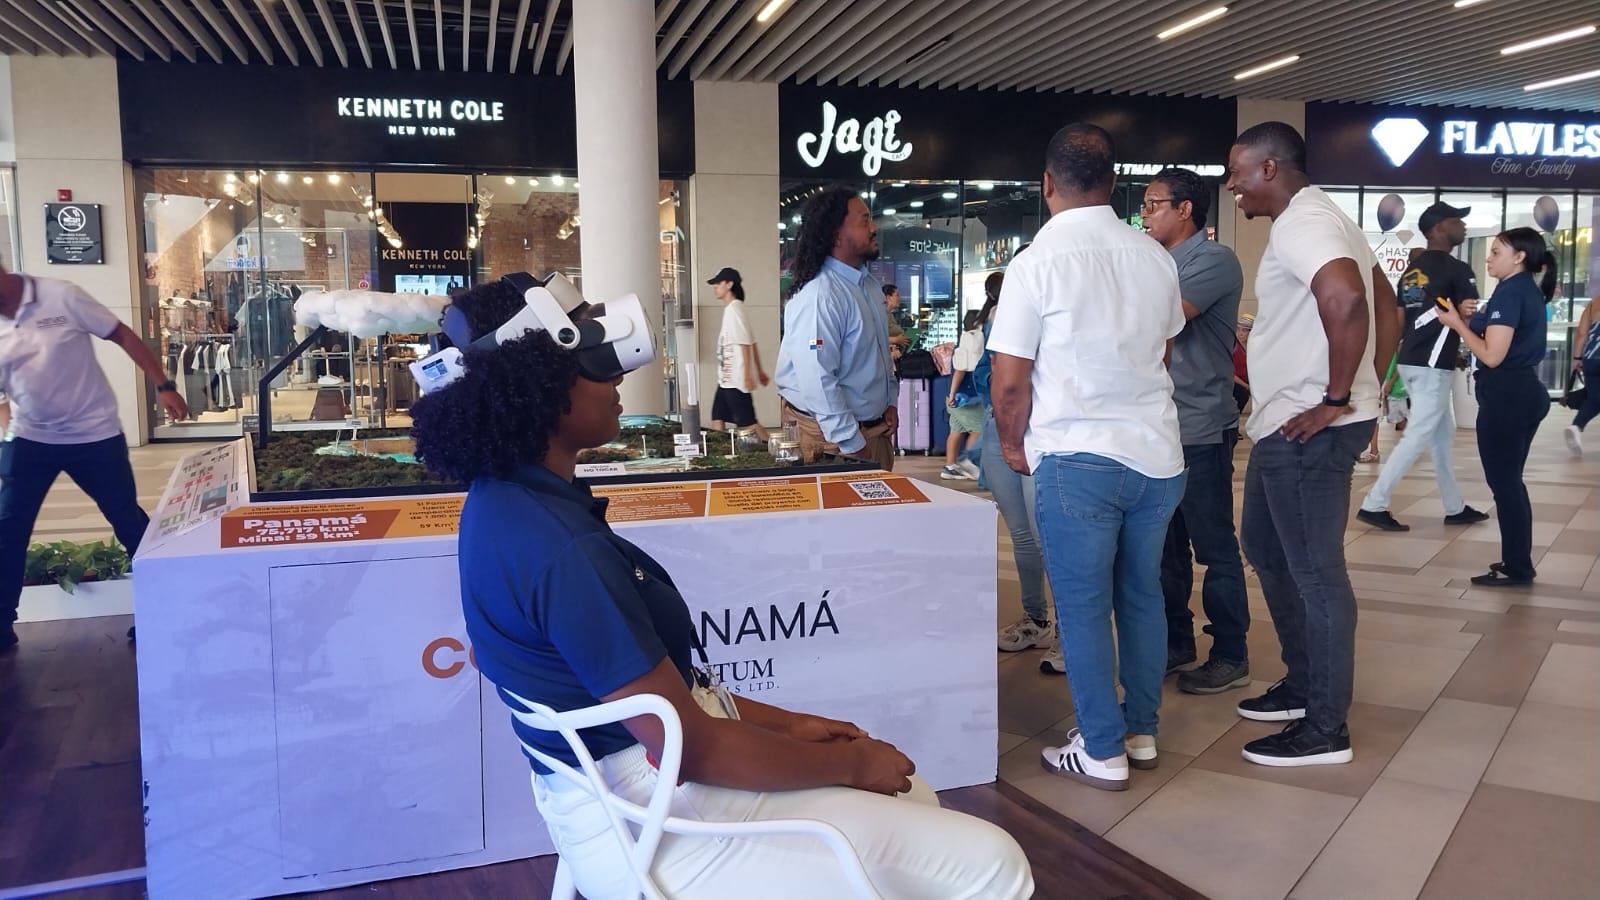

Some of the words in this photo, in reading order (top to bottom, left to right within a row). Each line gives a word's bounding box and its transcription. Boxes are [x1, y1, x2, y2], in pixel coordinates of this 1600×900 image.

[338, 97, 442, 119] KENNETH
[450, 100, 504, 121] COLE
[388, 125, 416, 135] NEW
[422, 126, 456, 137] YORK
[797, 100, 913, 177] Jagi
[1491, 156, 1522, 174] Fine
[1525, 158, 1576, 181] Jewelry
[382, 250, 438, 260] KENNETH
[444, 250, 472, 260] COLE
[1386, 248, 1410, 256] HAS
[244, 514, 368, 529] Panamá
[238, 535, 290, 544] Mina:
[324, 530, 360, 539] km²
[256, 526, 313, 536] 75,717
[320, 524, 355, 532] km²
[690, 590, 840, 649] NAMÁ
[422, 637, 478, 679] C
[749, 681, 780, 692] LTD.
